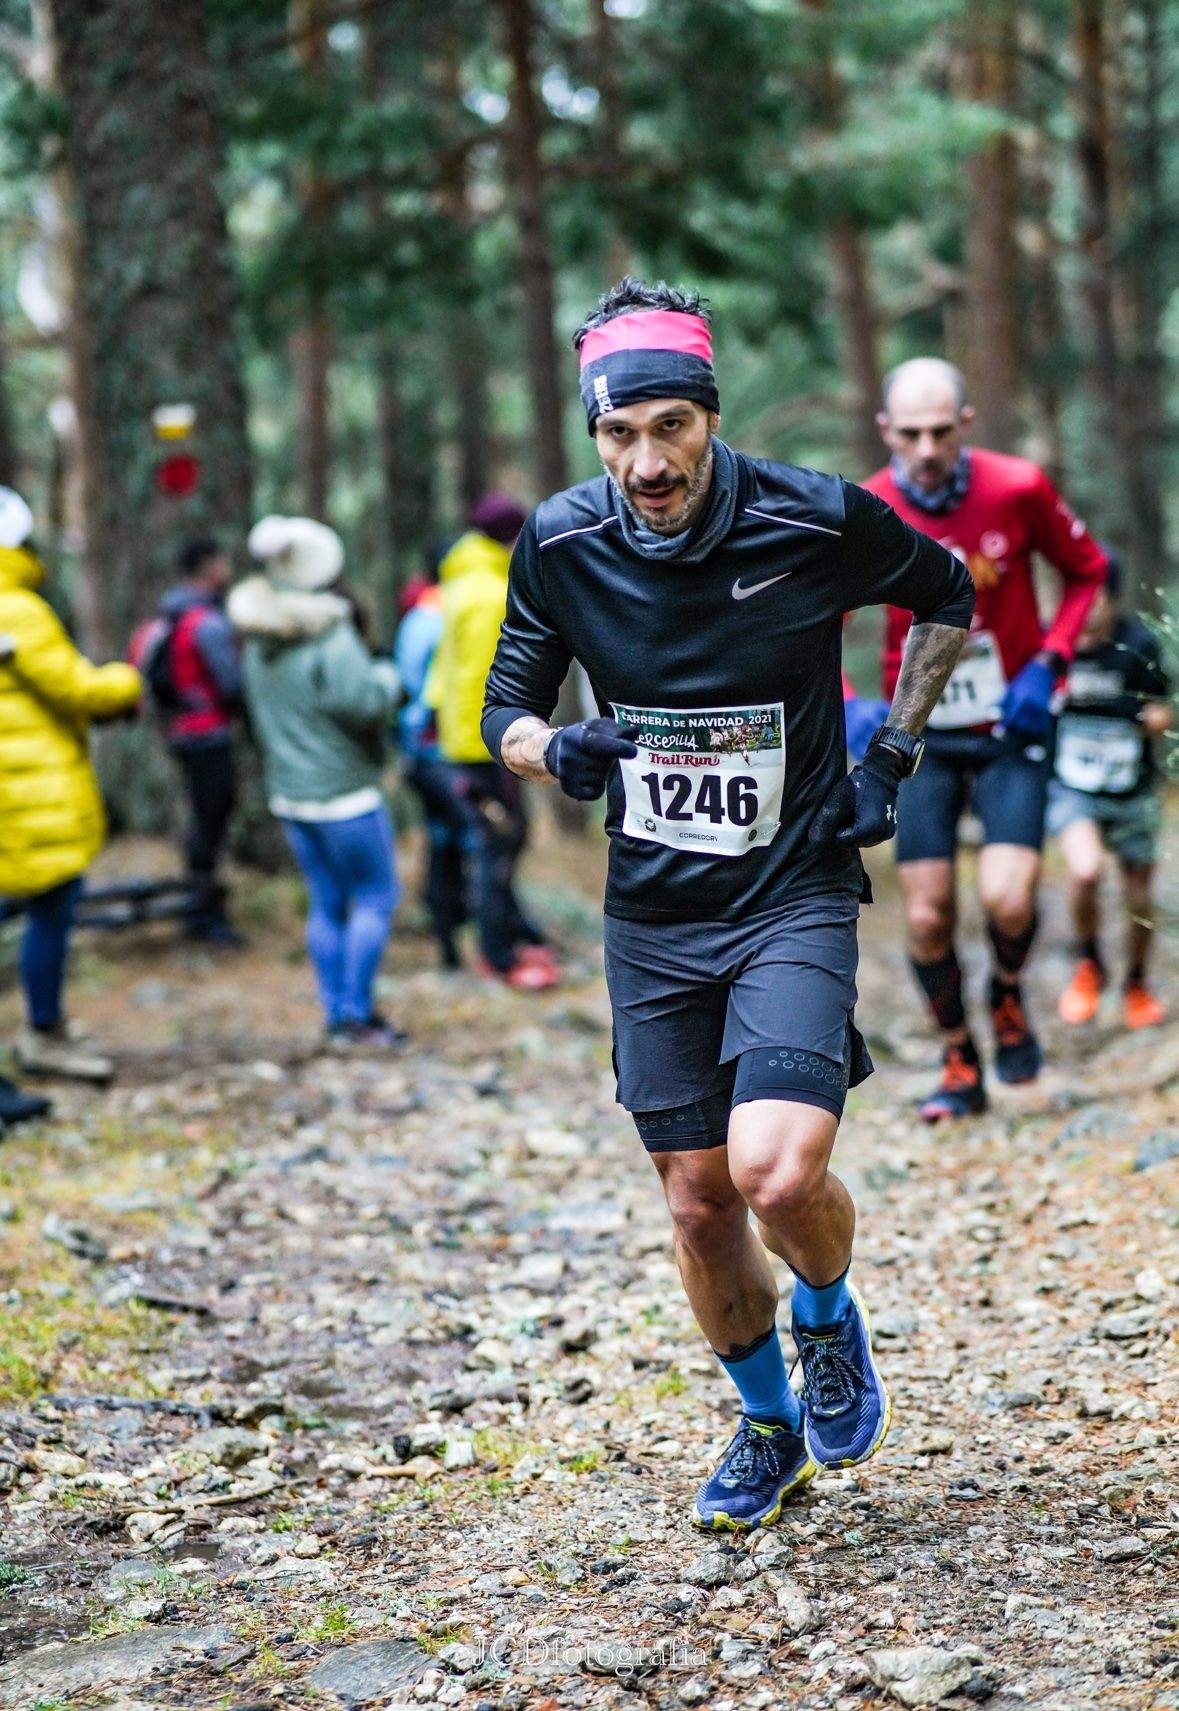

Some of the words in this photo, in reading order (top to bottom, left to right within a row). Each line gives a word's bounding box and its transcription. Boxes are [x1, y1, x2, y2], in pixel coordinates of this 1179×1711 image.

[620, 711, 671, 727] CARRERA
[673, 720, 686, 728] DE
[688, 716, 744, 728] NAVIDAD
[748, 714, 772, 725] 2021
[641, 772, 758, 827] 1246
